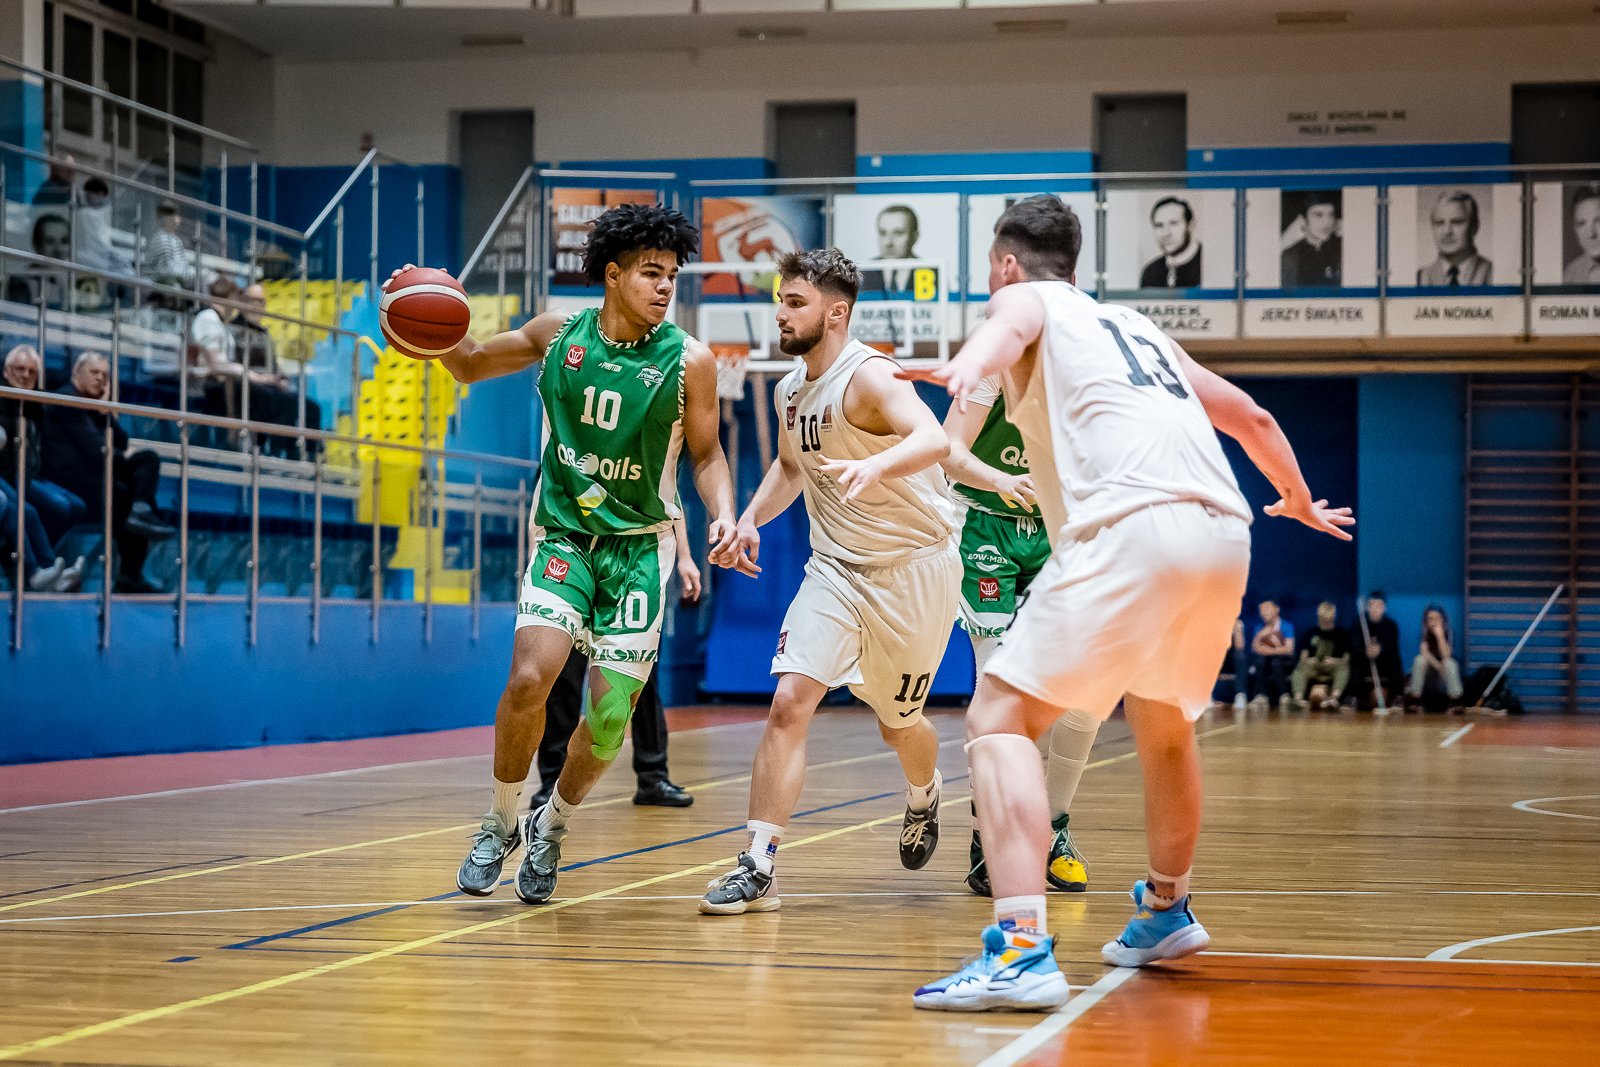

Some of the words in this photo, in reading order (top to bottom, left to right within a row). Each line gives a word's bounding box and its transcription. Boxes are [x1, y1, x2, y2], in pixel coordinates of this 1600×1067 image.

[914, 268, 937, 301] B
[1136, 304, 1201, 316] MAREK
[1260, 306, 1300, 321] JERZY
[1414, 306, 1440, 319] JAN
[1443, 305, 1494, 319] NOWAK
[1539, 305, 1590, 319] ROMAN
[1097, 317, 1189, 400] 13
[580, 385, 623, 431] 10
[800, 414, 822, 452] 10
[600, 456, 642, 481] Oils
[609, 590, 648, 629] 10
[894, 672, 931, 702] 10
